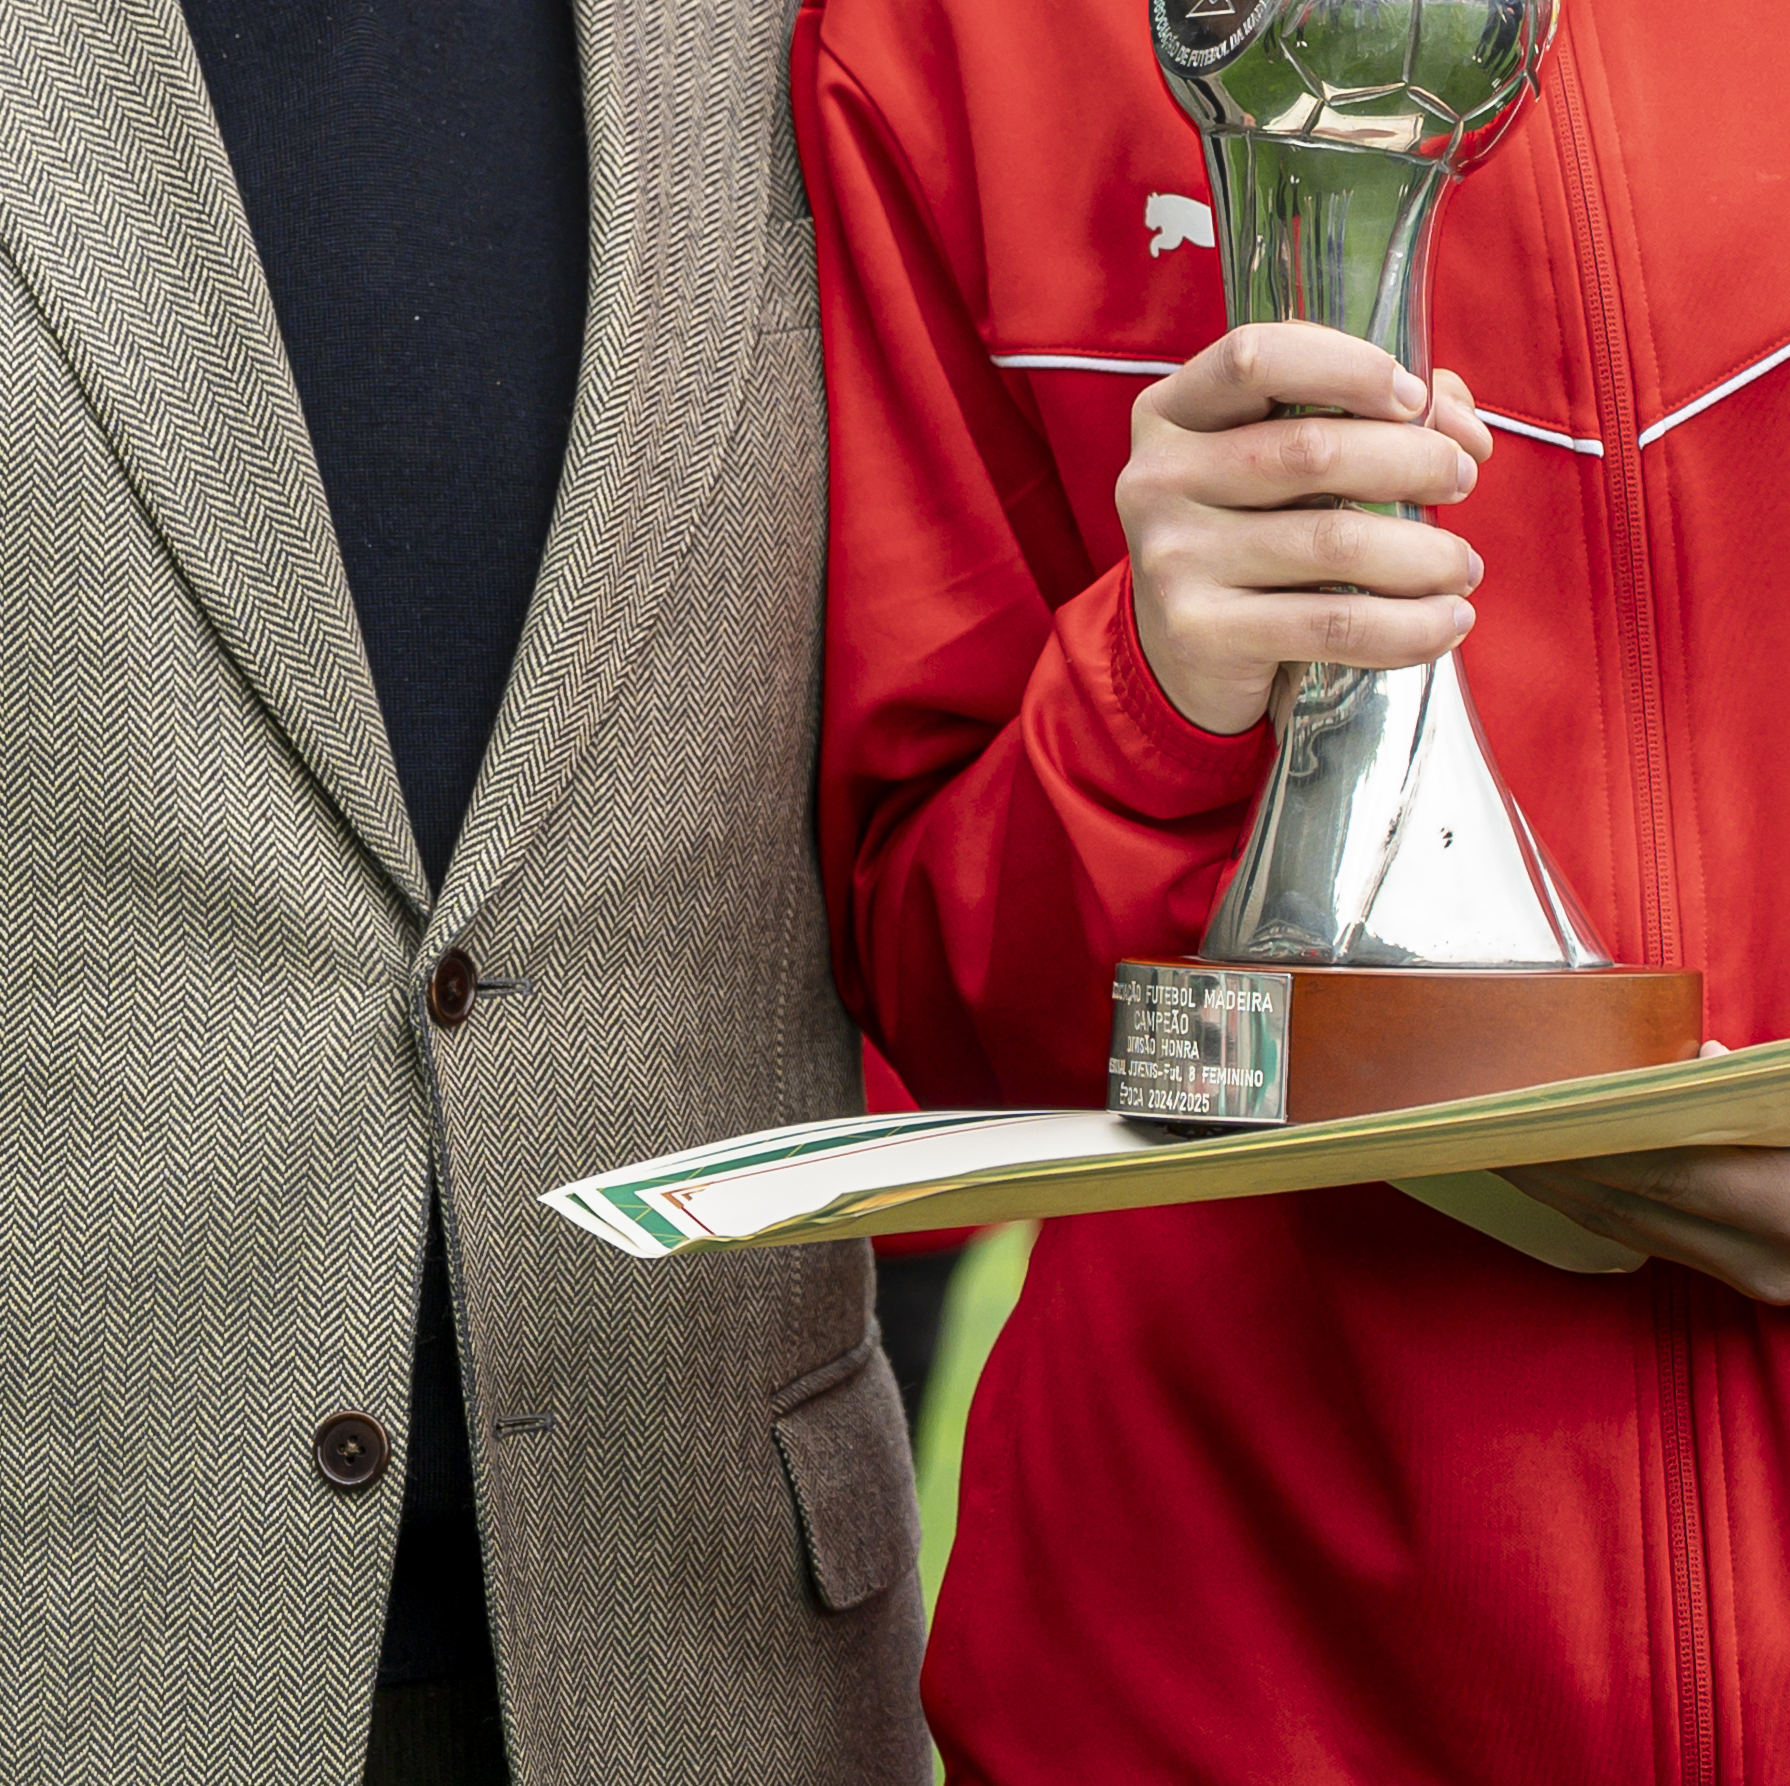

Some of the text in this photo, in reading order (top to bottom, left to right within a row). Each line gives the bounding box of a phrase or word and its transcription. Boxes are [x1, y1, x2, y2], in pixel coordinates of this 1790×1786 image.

[1187, 40, 1230, 68] FUTEBOL
[1145, 985, 1196, 1008] FUTEBOL
[1203, 989, 1274, 1013] MADEIRA
[1134, 1009, 1189, 1035] CAMPEÃO
[1161, 1039, 1200, 1060] HONRA
[1189, 1065, 1196, 1082] 8
[1202, 1067, 1264, 1088] FEMININO
[1119, 1082, 1210, 1113] ÉPOCA 2024/2025
